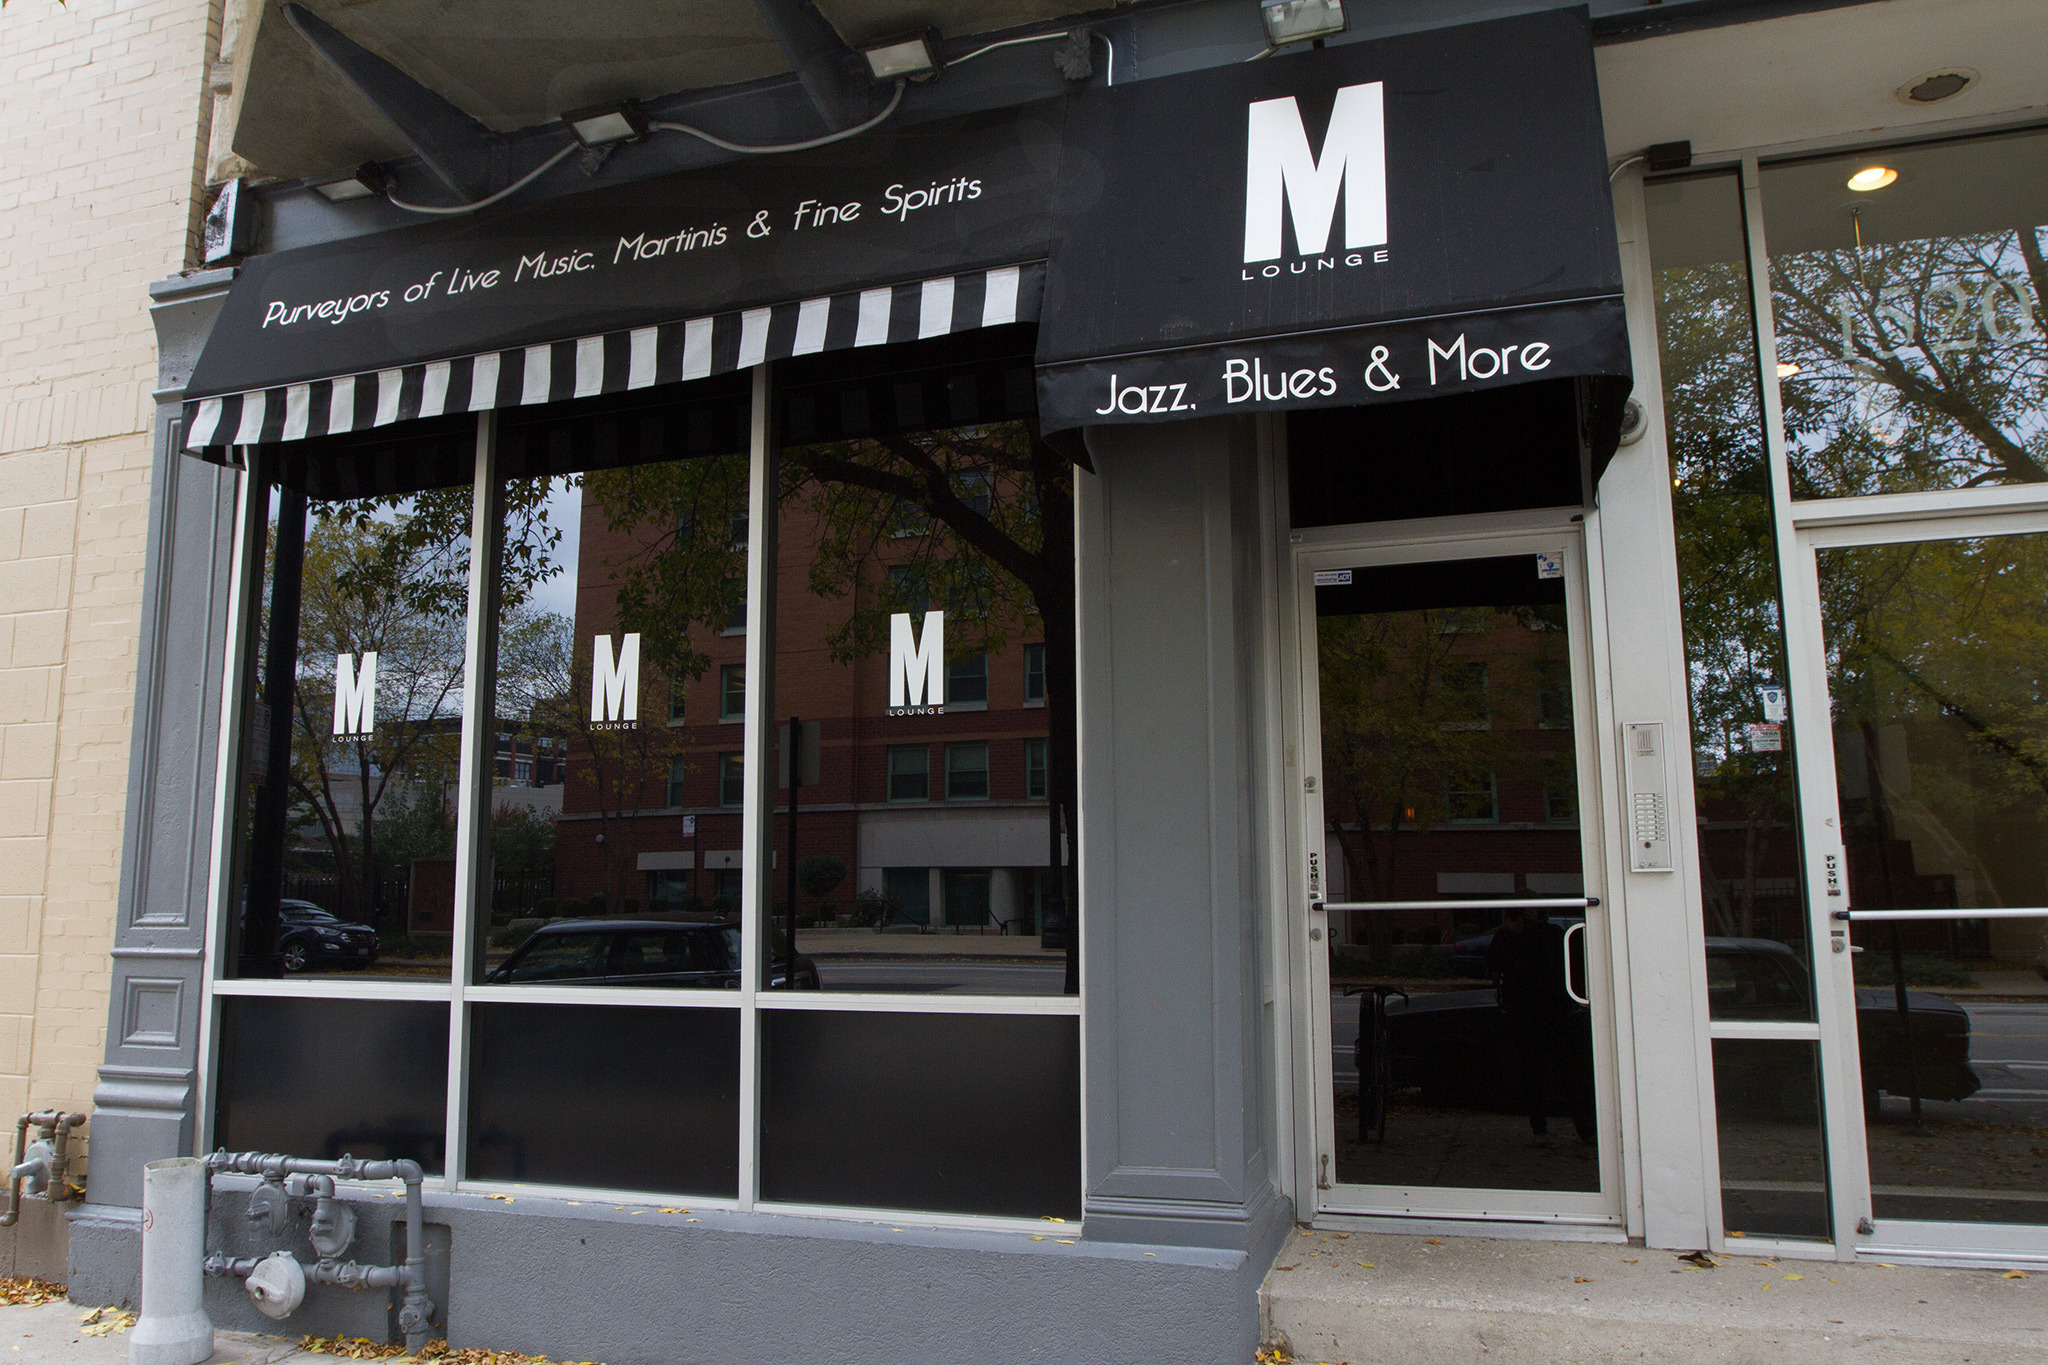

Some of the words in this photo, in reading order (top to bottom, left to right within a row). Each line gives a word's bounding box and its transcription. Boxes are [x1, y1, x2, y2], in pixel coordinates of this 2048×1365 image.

[1243, 80, 1388, 263] M
[262, 290, 390, 328] Purveyors
[403, 270, 443, 302] of
[447, 267, 500, 295] Live
[613, 222, 728, 264] Martinis
[746, 209, 772, 239] &
[794, 199, 861, 231] Fine
[880, 176, 982, 222] Spirits
[1242, 249, 1389, 281] LOUNGE
[1833, 278, 2034, 362] 1520
[1221, 357, 1338, 404] Blues
[1364, 344, 1401, 392] &
[1427, 332, 1552, 386] More
[333, 651, 378, 735] M
[591, 632, 641, 722] M
[889, 610, 944, 707] M
[332, 735, 374, 743] LOUNGE
[590, 722, 638, 731] LOUNGE
[889, 707, 944, 717] LOUNGE
[1826, 855, 1838, 884] PUSH
